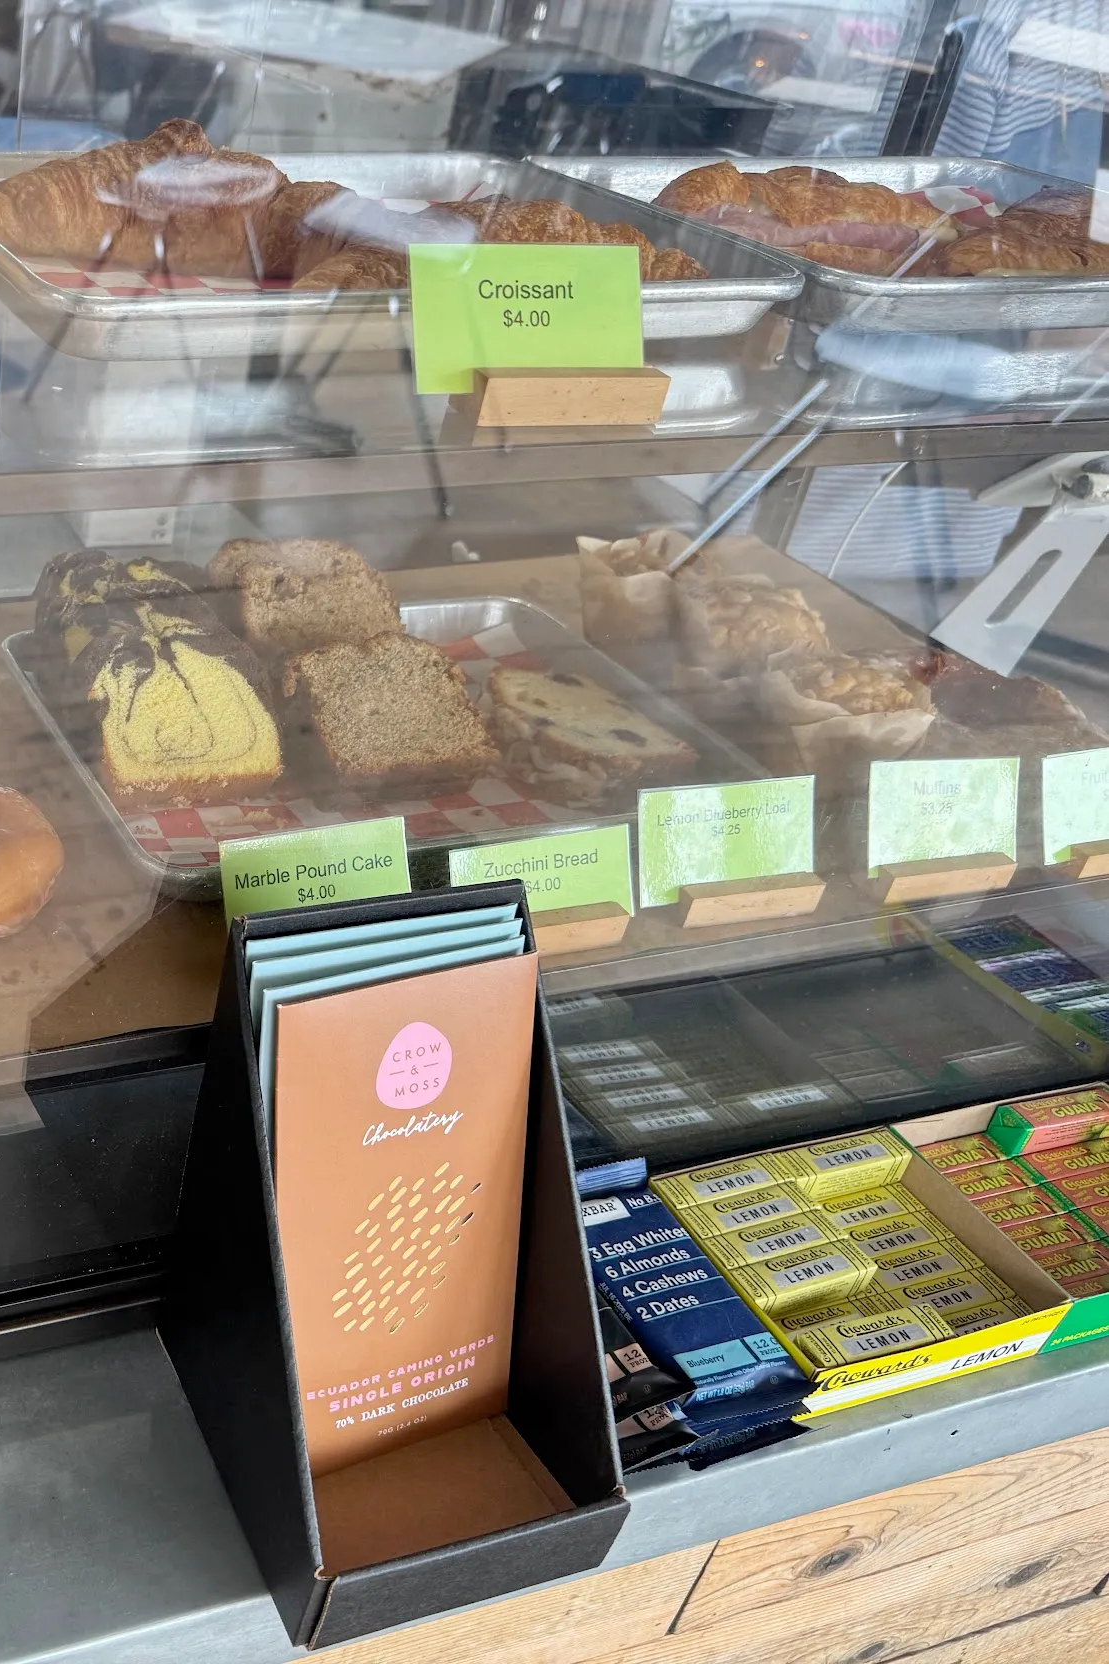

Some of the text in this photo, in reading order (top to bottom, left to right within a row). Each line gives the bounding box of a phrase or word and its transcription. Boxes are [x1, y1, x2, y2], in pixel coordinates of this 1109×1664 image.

[478, 279, 574, 299] Croissant
[503, 309, 551, 328] $4.00
[657, 813, 700, 827] Lemon
[704, 804, 763, 823] Blueberry
[234, 854, 393, 890] Marble Pound Cake
[483, 848, 599, 878] Zucchini Bread
[297, 884, 336, 903] $4.00
[525, 877, 561, 894] $4.00
[392, 1042, 442, 1062] CROW
[410, 1065, 419, 1075] &
[394, 1077, 440, 1097] MOSS
[1051, 1102, 1103, 1118] GUAVA
[362, 1110, 464, 1146] Chocolatery
[825, 1149, 872, 1168] LEMON
[933, 1150, 985, 1169] GUAVA
[707, 1174, 755, 1193] LEMON
[959, 1175, 1012, 1195] GUAVA
[581, 1201, 617, 1216] XBAR
[626, 1197, 643, 1207] No
[731, 1203, 780, 1224] LEMON
[840, 1205, 889, 1224] LEMON
[987, 1203, 1042, 1223] GUAVA
[588, 1246, 602, 1259] 3
[600, 1240, 637, 1256] Egg
[757, 1232, 806, 1253] LEMON
[868, 1232, 917, 1252] LEMON
[1016, 1231, 1072, 1251] GUAVA
[604, 1265, 619, 1279] 6
[621, 1248, 691, 1275] Almonds
[784, 1261, 835, 1284] LEMON
[893, 1261, 944, 1282] LEMON
[1045, 1259, 1103, 1280] GUAVA
[622, 1268, 709, 1298] 4 Cashews
[637, 1295, 700, 1320] 2 Dates
[929, 1290, 973, 1310] EMON
[752, 1338, 770, 1350] 12
[856, 1329, 911, 1351] LEMON
[624, 1348, 642, 1362] 12
[687, 1353, 725, 1368] Blueberry
[950, 1340, 1025, 1370] LEMON
[306, 1334, 495, 1401] ECUADOR CAMINO VERDE
[329, 1356, 476, 1413] SINGLE ORIGIN
[695, 1391, 708, 1402] NET
[707, 1389, 717, 1398] WT
[724, 1384, 733, 1395] OZ
[335, 1377, 469, 1429] 70% DARK CHOCOLATE
